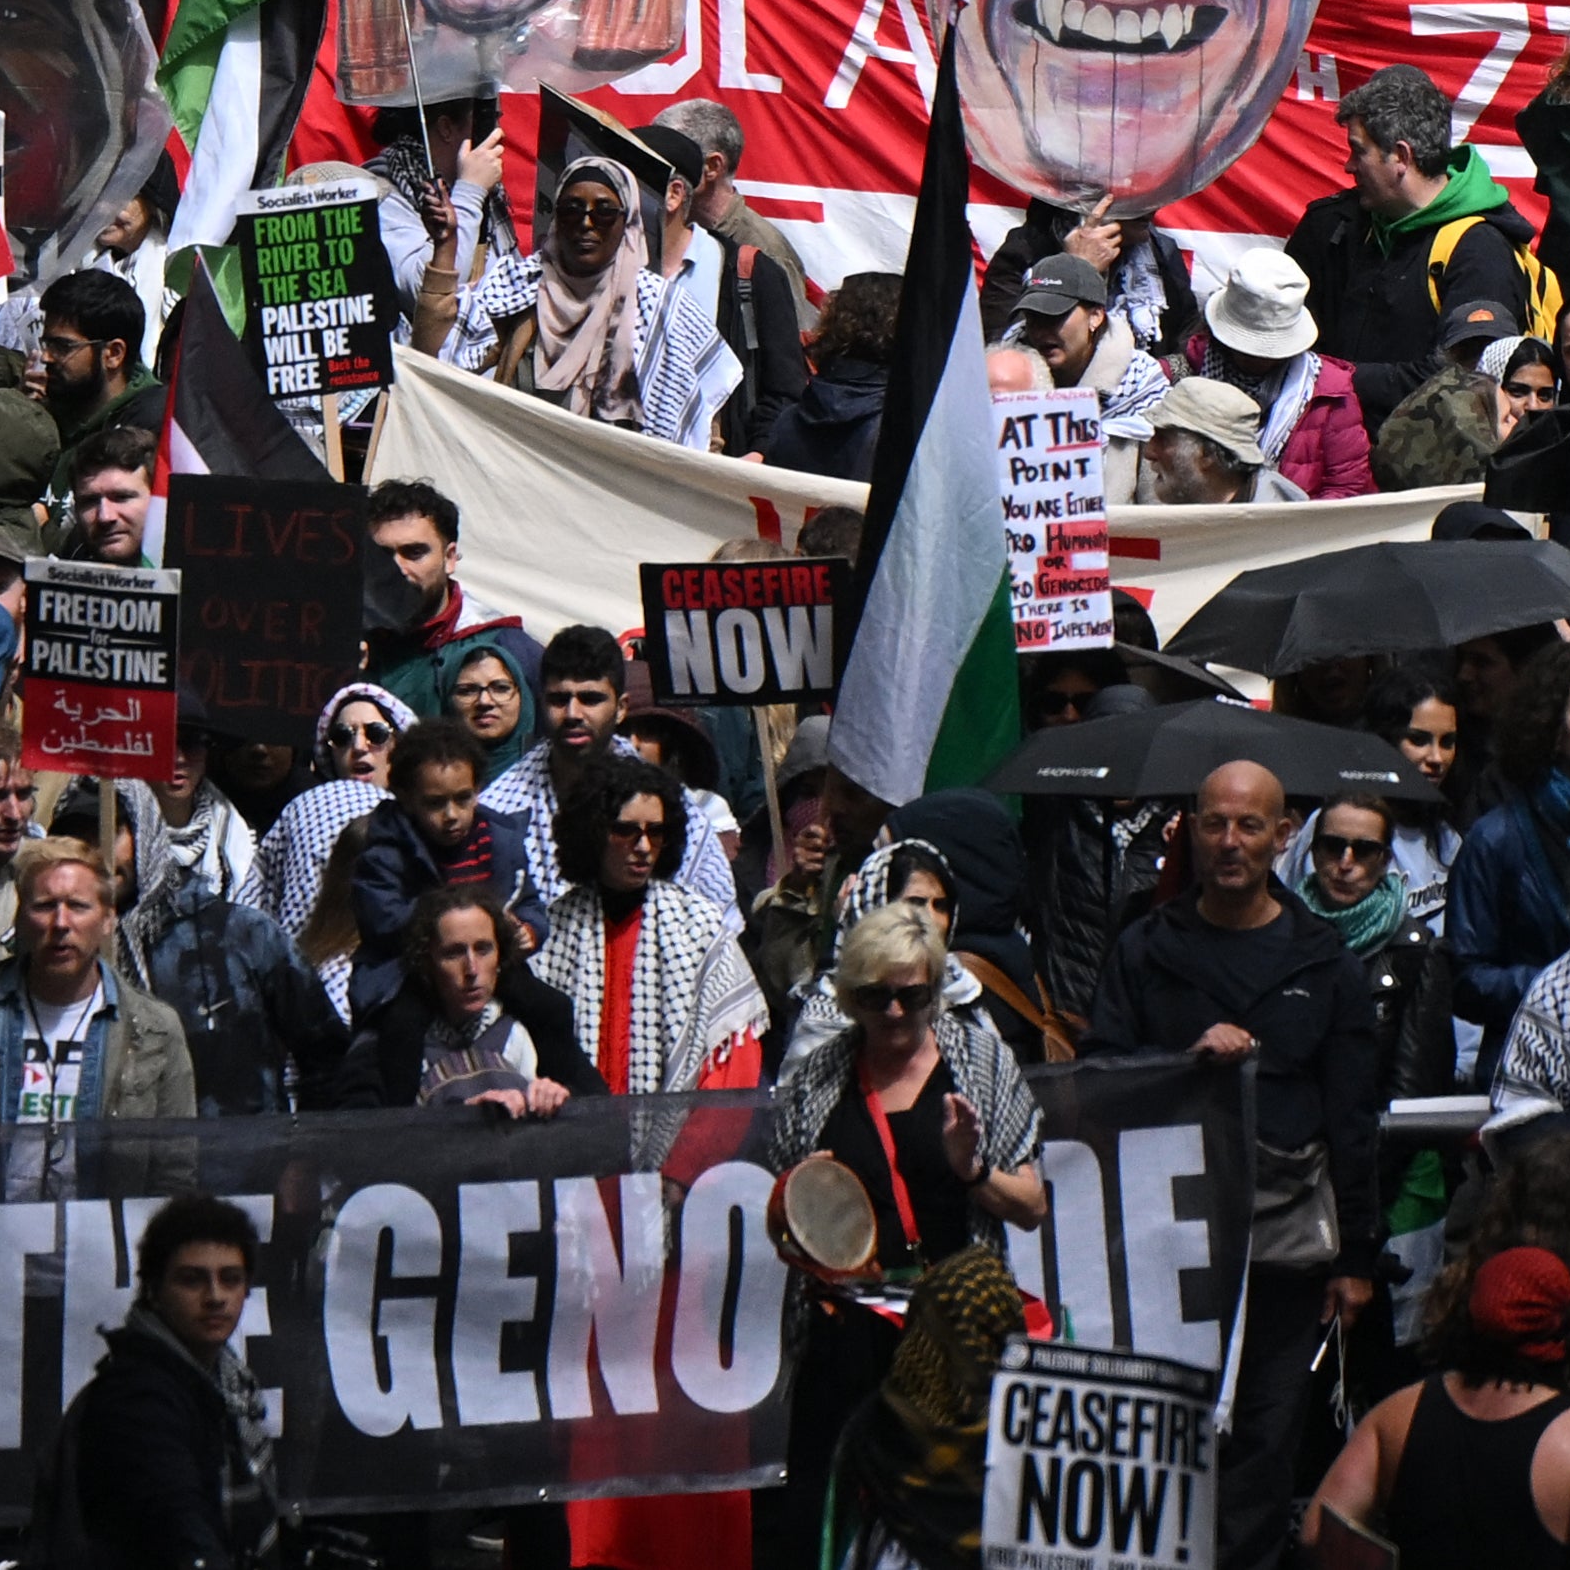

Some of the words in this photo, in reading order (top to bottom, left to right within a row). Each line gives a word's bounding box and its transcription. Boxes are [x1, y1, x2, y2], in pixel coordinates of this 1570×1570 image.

[254, 212, 317, 245] FROM
[321, 206, 364, 236] THE
[256, 242, 320, 275] RIVER
[325, 238, 355, 266] TO
[258, 274, 301, 305] THE
[308, 268, 348, 300] SEA
[261, 293, 376, 335] PALESTINE
[263, 332, 319, 366] WILL
[322, 327, 351, 358] BE
[267, 362, 322, 395] FREE
[998, 413, 1038, 450] AT
[1035, 498, 1063, 519] ARE
[1066, 491, 1104, 515] EITHER
[184, 502, 356, 565] LIVES
[47, 567, 104, 586] Socialist
[106, 572, 156, 589] Worker
[1043, 556, 1067, 570] OR
[662, 565, 833, 609] CEASEFIRE
[1038, 573, 1110, 596] GENOCIDE
[38, 589, 162, 633] FREEDOM
[1015, 600, 1063, 619] THERE
[664, 605, 834, 694] NOW
[1017, 620, 1046, 644] NO
[32, 639, 168, 684] PALESTINE
[53, 689, 142, 726] الحرية
[41, 726, 155, 757] لفلسطين
[322, 1123, 1225, 1442] GENODE
[1003, 1381, 1210, 1474] CEASEFIRE
[1016, 1452, 1192, 1564] NOW!
